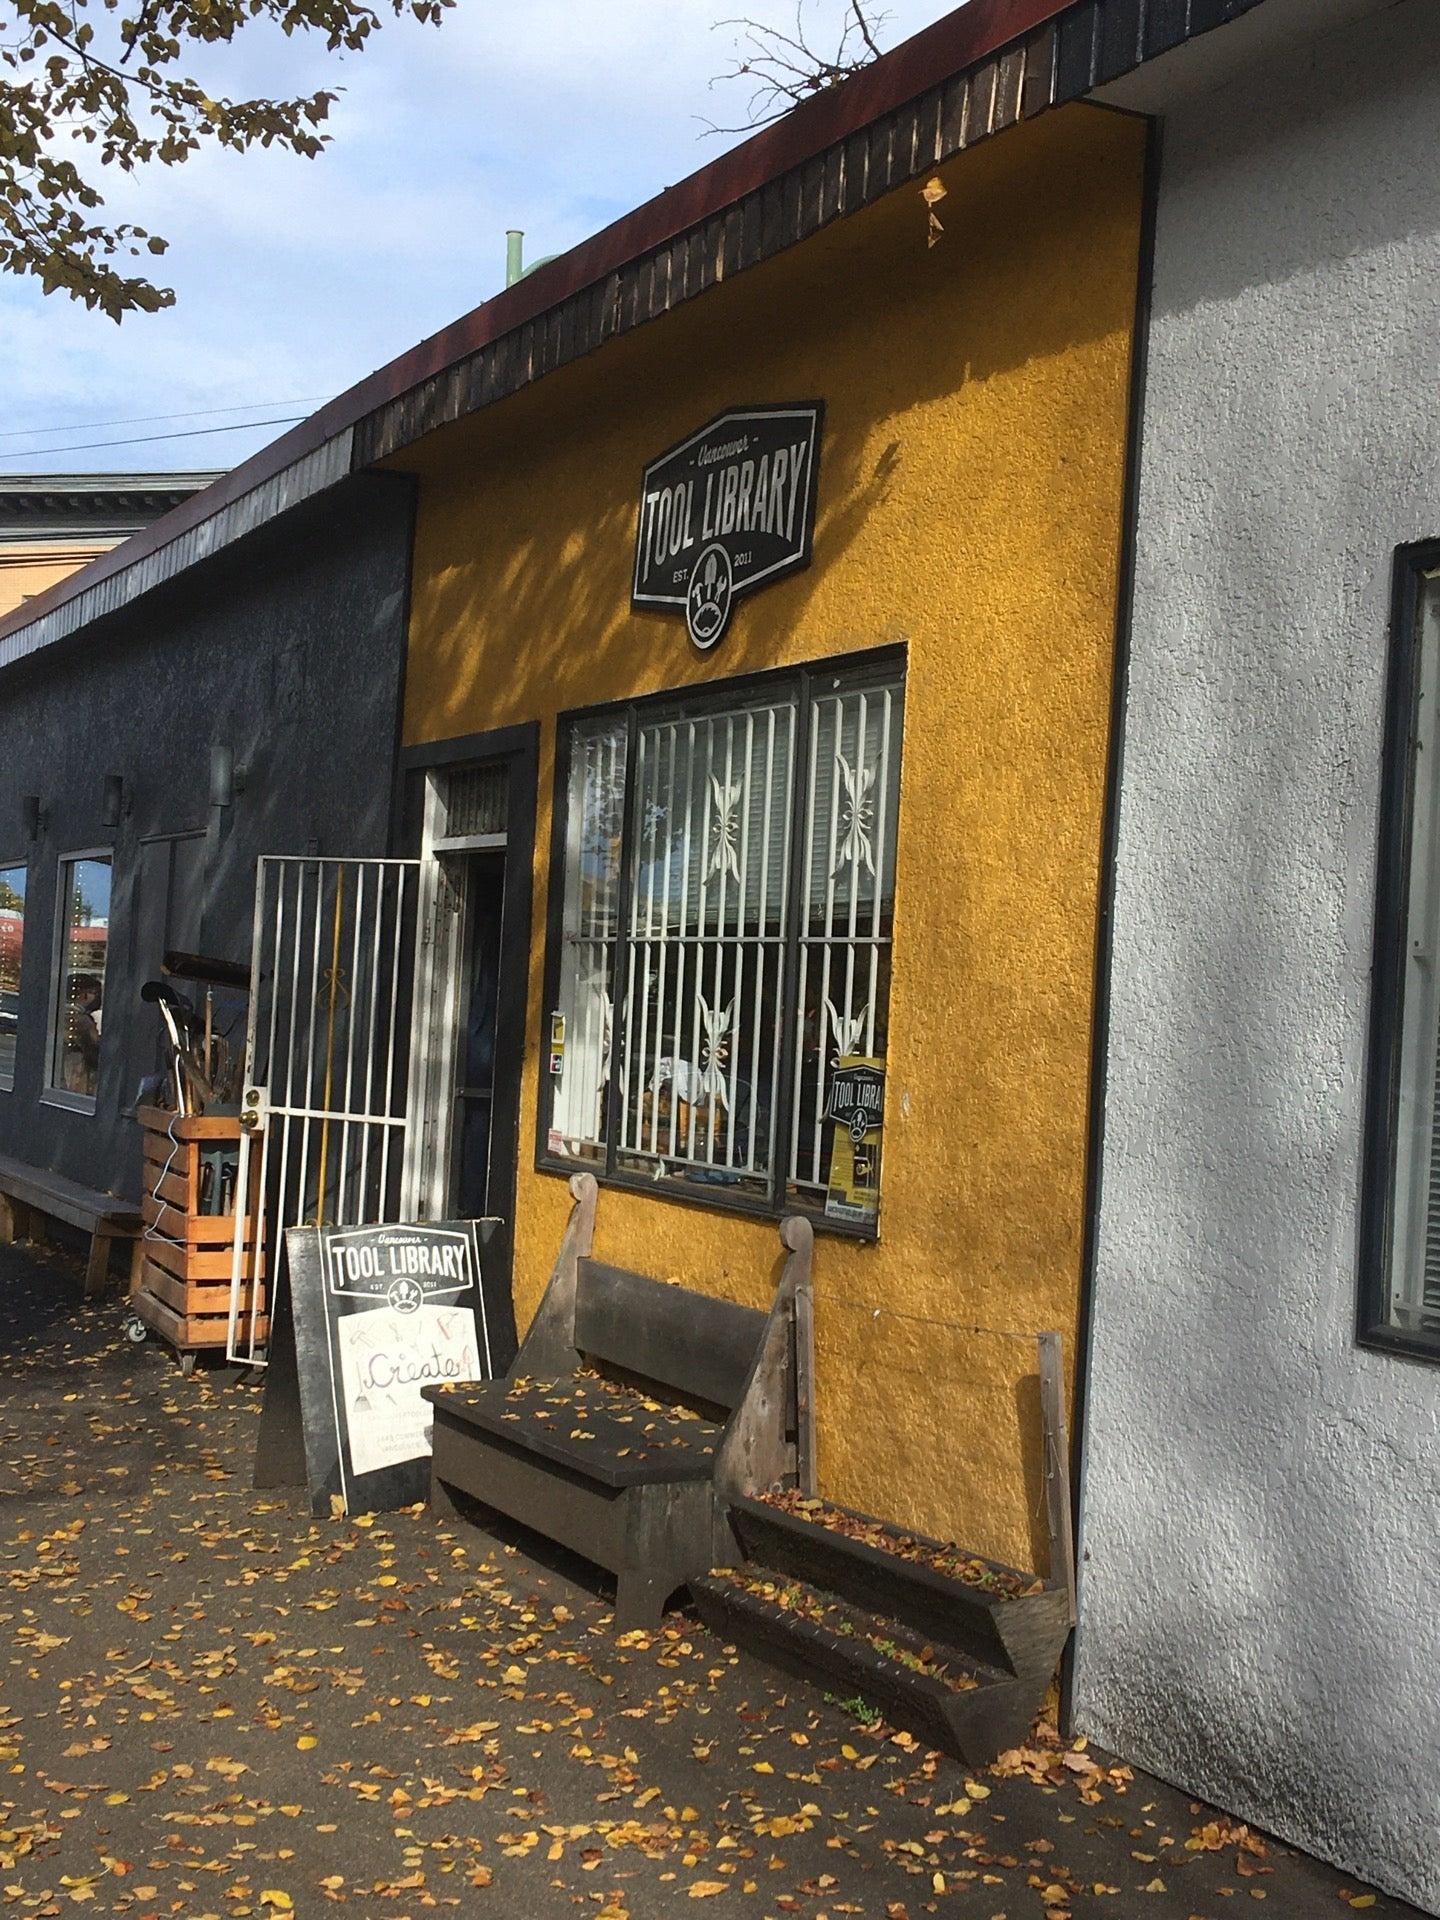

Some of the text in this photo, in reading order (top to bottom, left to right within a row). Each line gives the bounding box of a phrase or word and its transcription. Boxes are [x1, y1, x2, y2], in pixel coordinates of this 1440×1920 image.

[698, 434, 749, 467] Vancouver
[643, 440, 807, 583] TOOL LIBRARY
[673, 551, 752, 584] EST. 2011
[833, 1081, 884, 1113] TOOL LIBRA
[332, 1244, 465, 1288] TOOL LIBRARY
[363, 1343, 460, 1389] Create
